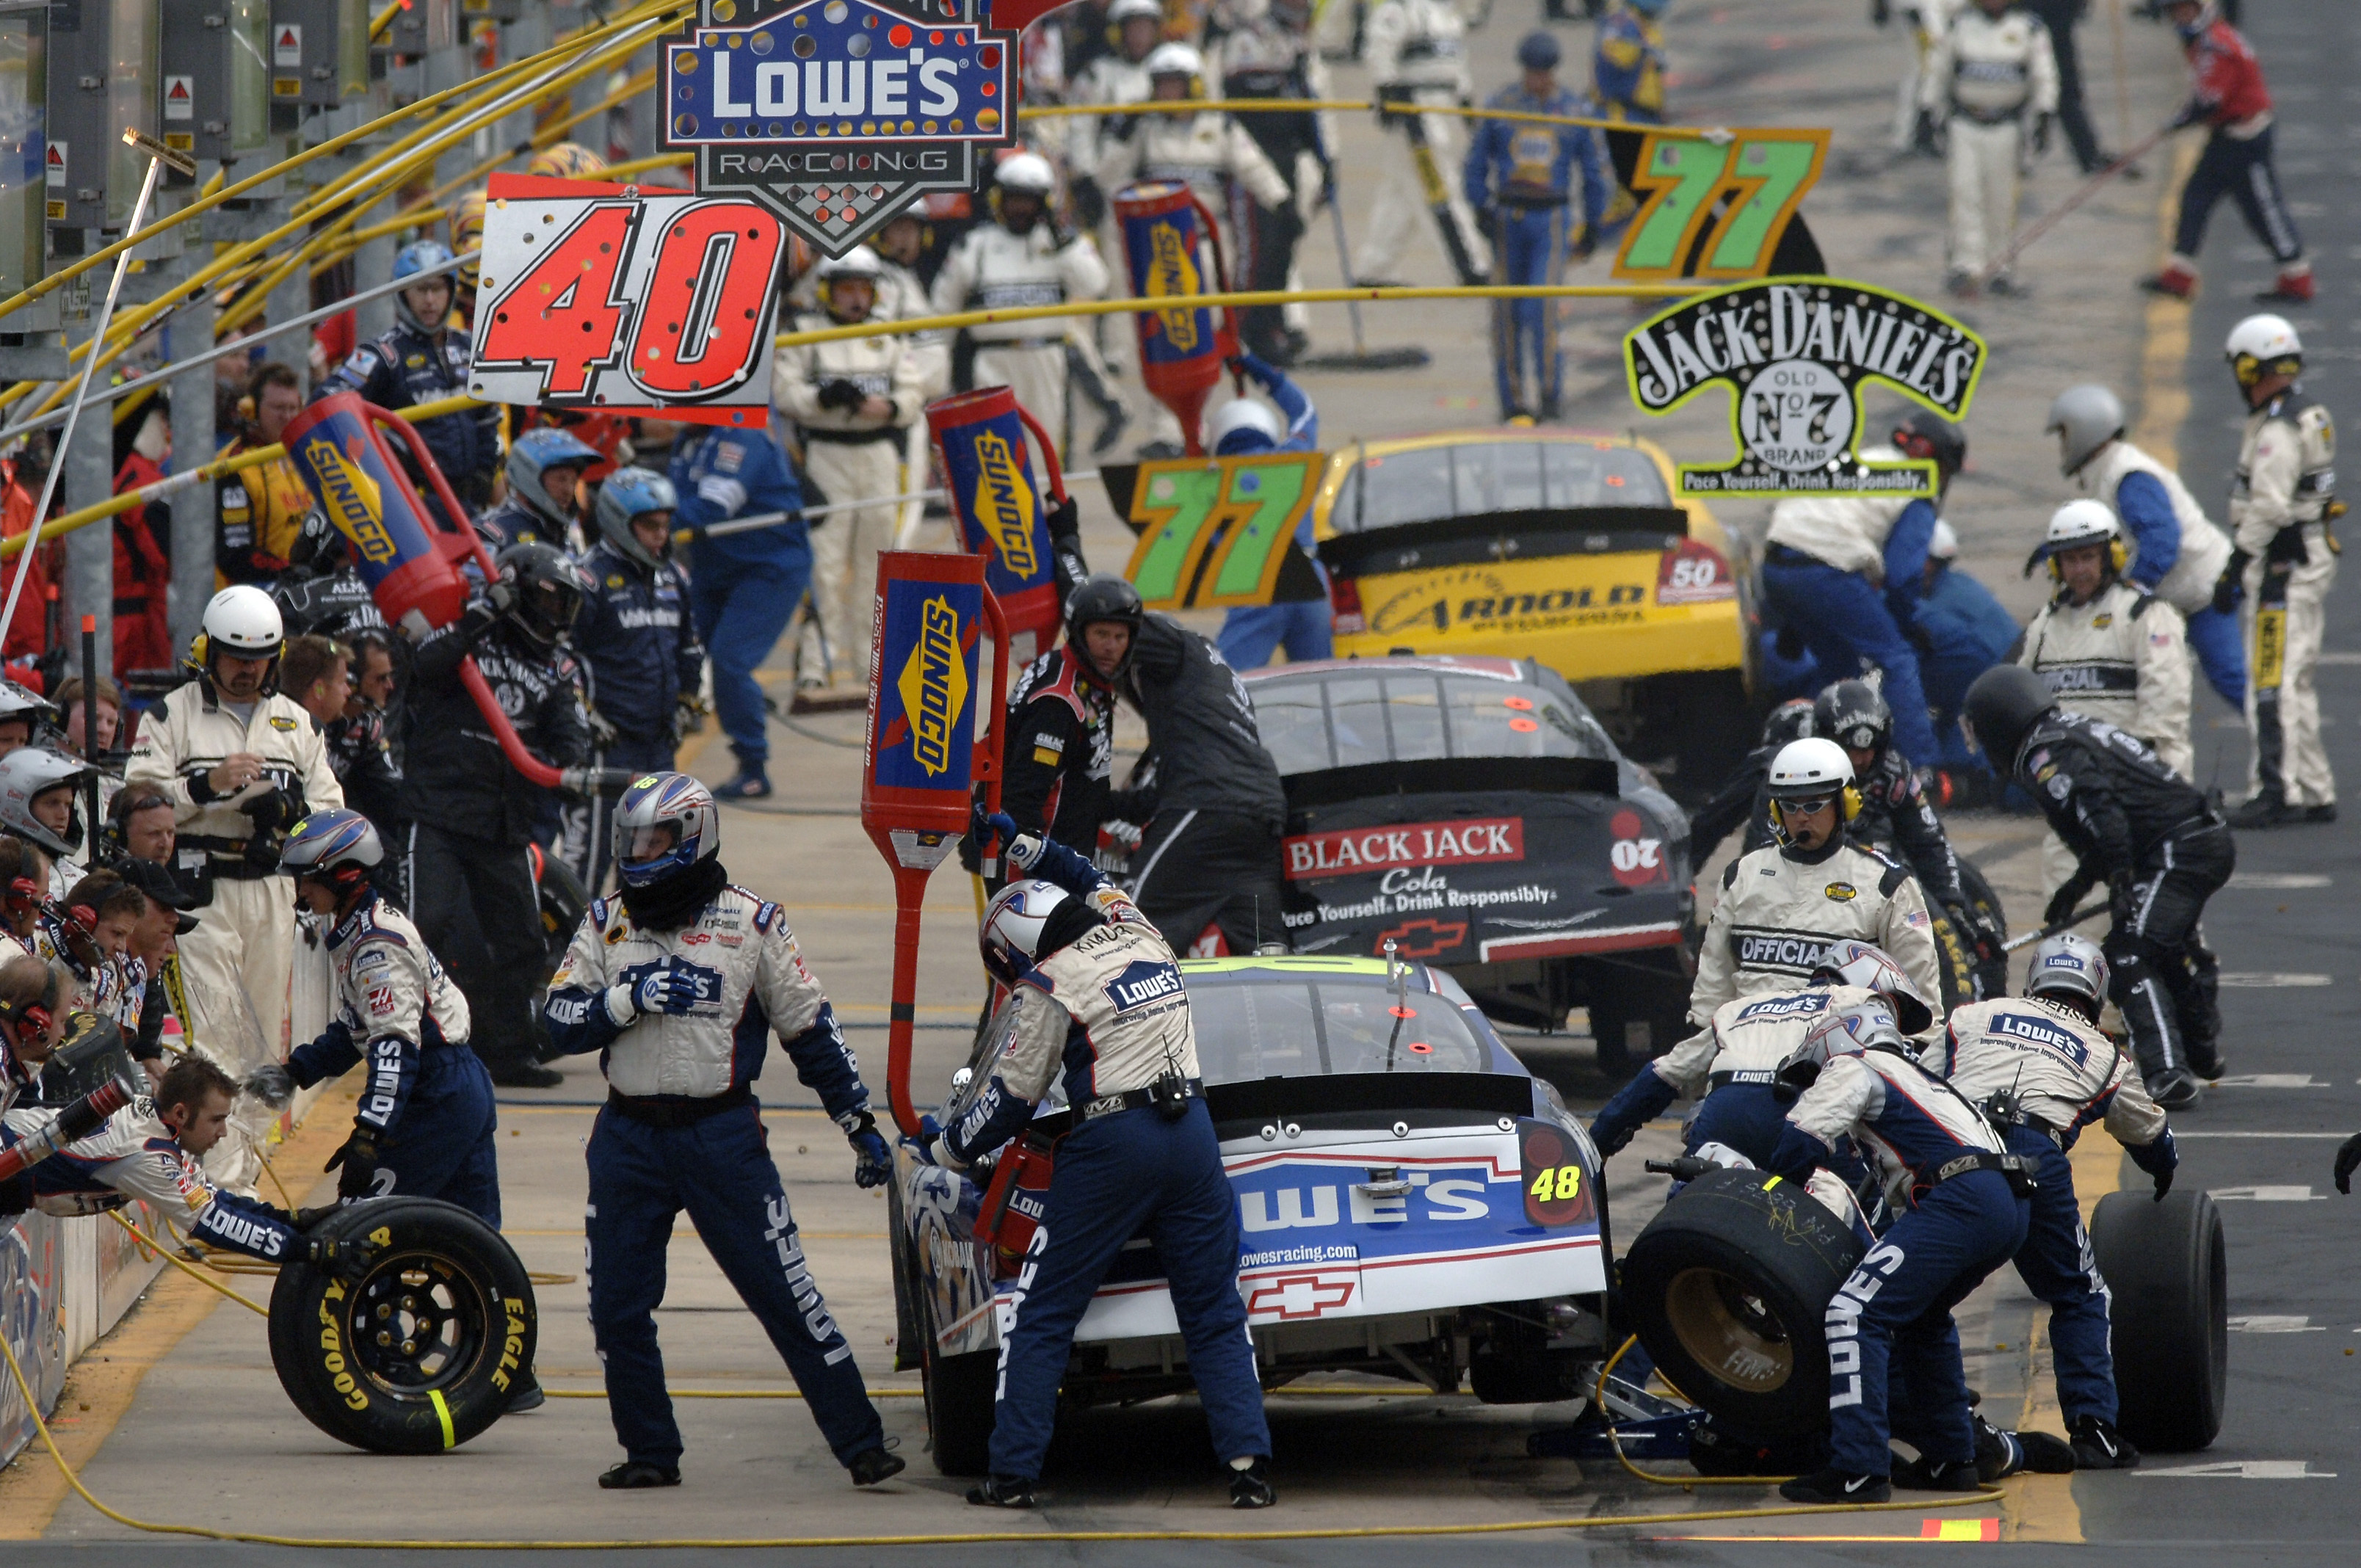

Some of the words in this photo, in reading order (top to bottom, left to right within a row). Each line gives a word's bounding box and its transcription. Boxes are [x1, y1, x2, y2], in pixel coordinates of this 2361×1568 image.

[714, 48, 959, 117] LOWE'S
[719, 150, 948, 173] RACING
[1614, 129, 1831, 277] 77
[470, 198, 784, 404] 40
[1631, 305, 1766, 406] JACK
[1768, 285, 1975, 405] DANIEL'S
[1774, 370, 1818, 387] OLD
[1764, 448, 1827, 465] BRAND
[1788, 472, 1829, 490] Drink
[305, 442, 398, 562] SUNOCO
[980, 440, 1034, 570] SUNOCO
[1125, 454, 1323, 608] 77
[1669, 558, 1716, 588] 50
[916, 602, 957, 774] SUNOCO
[1290, 831, 1412, 872] BLACK
[1422, 824, 1513, 860] JACK
[1379, 866, 1448, 896] Cola
[1283, 910, 1314, 929] ace
[1395, 890, 1444, 912] Drink
[1117, 970, 1179, 1006] LOWE'S
[1747, 996, 1819, 1016] LOWE'S
[1980, 1037, 2017, 1050] Improving
[2002, 1016, 2078, 1059] LOWE'S
[362, 1039, 403, 1126] LOWE'S
[960, 1084, 1003, 1147] OWE'S
[1239, 1172, 1490, 1233] WE'S
[1530, 1165, 1581, 1203] 48
[199, 1199, 283, 1257] LOWE'S
[1239, 1244, 1358, 1269] owesracing.com
[318, 1224, 393, 1412] GOODYR
[490, 1296, 526, 1394] EAGLE
